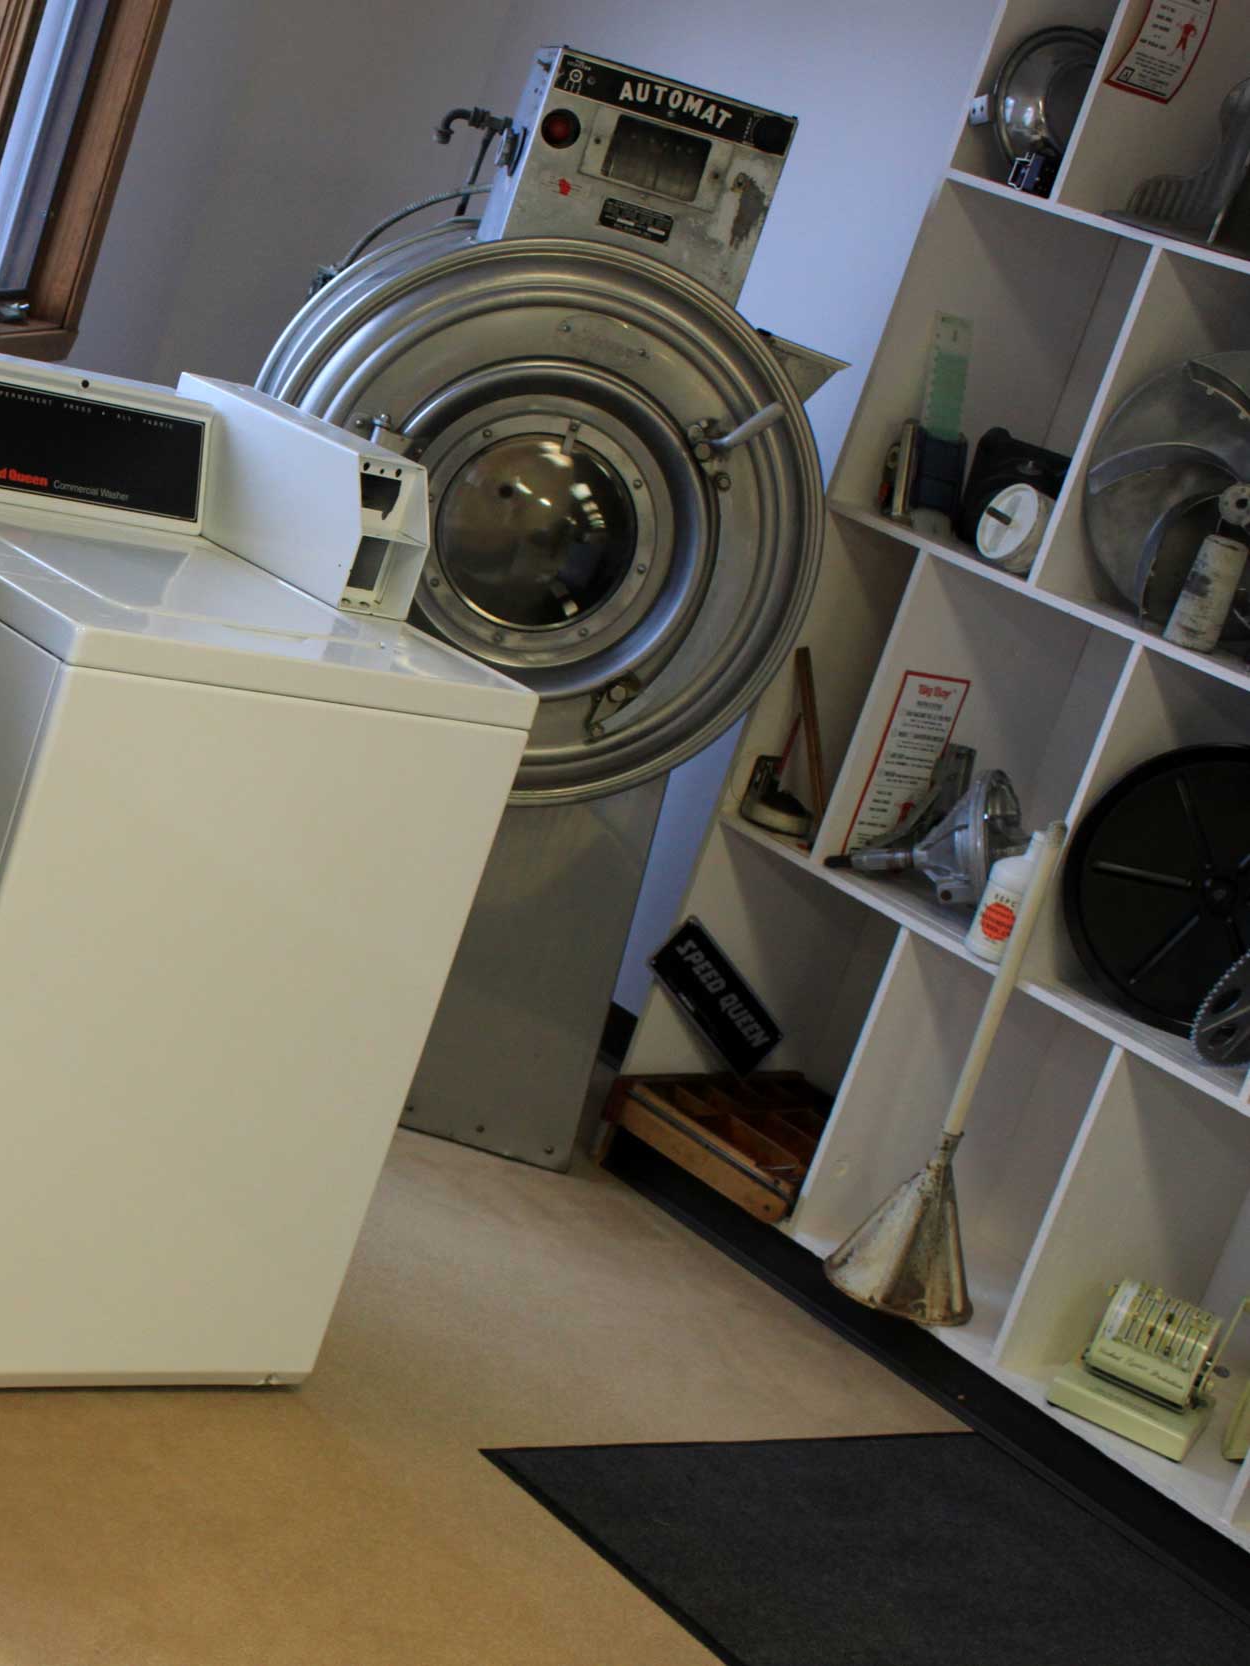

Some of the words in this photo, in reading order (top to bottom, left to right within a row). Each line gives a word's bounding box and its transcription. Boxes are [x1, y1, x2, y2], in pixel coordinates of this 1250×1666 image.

[619, 81, 732, 129] AUTOMAT
[63, 402, 93, 414] PRESS
[8, 468, 48, 487] Queen
[53, 479, 99, 496] Commercial
[100, 486, 129, 501] Washer
[676, 940, 726, 993] SPEED
[720, 994, 770, 1047] QUEEN
